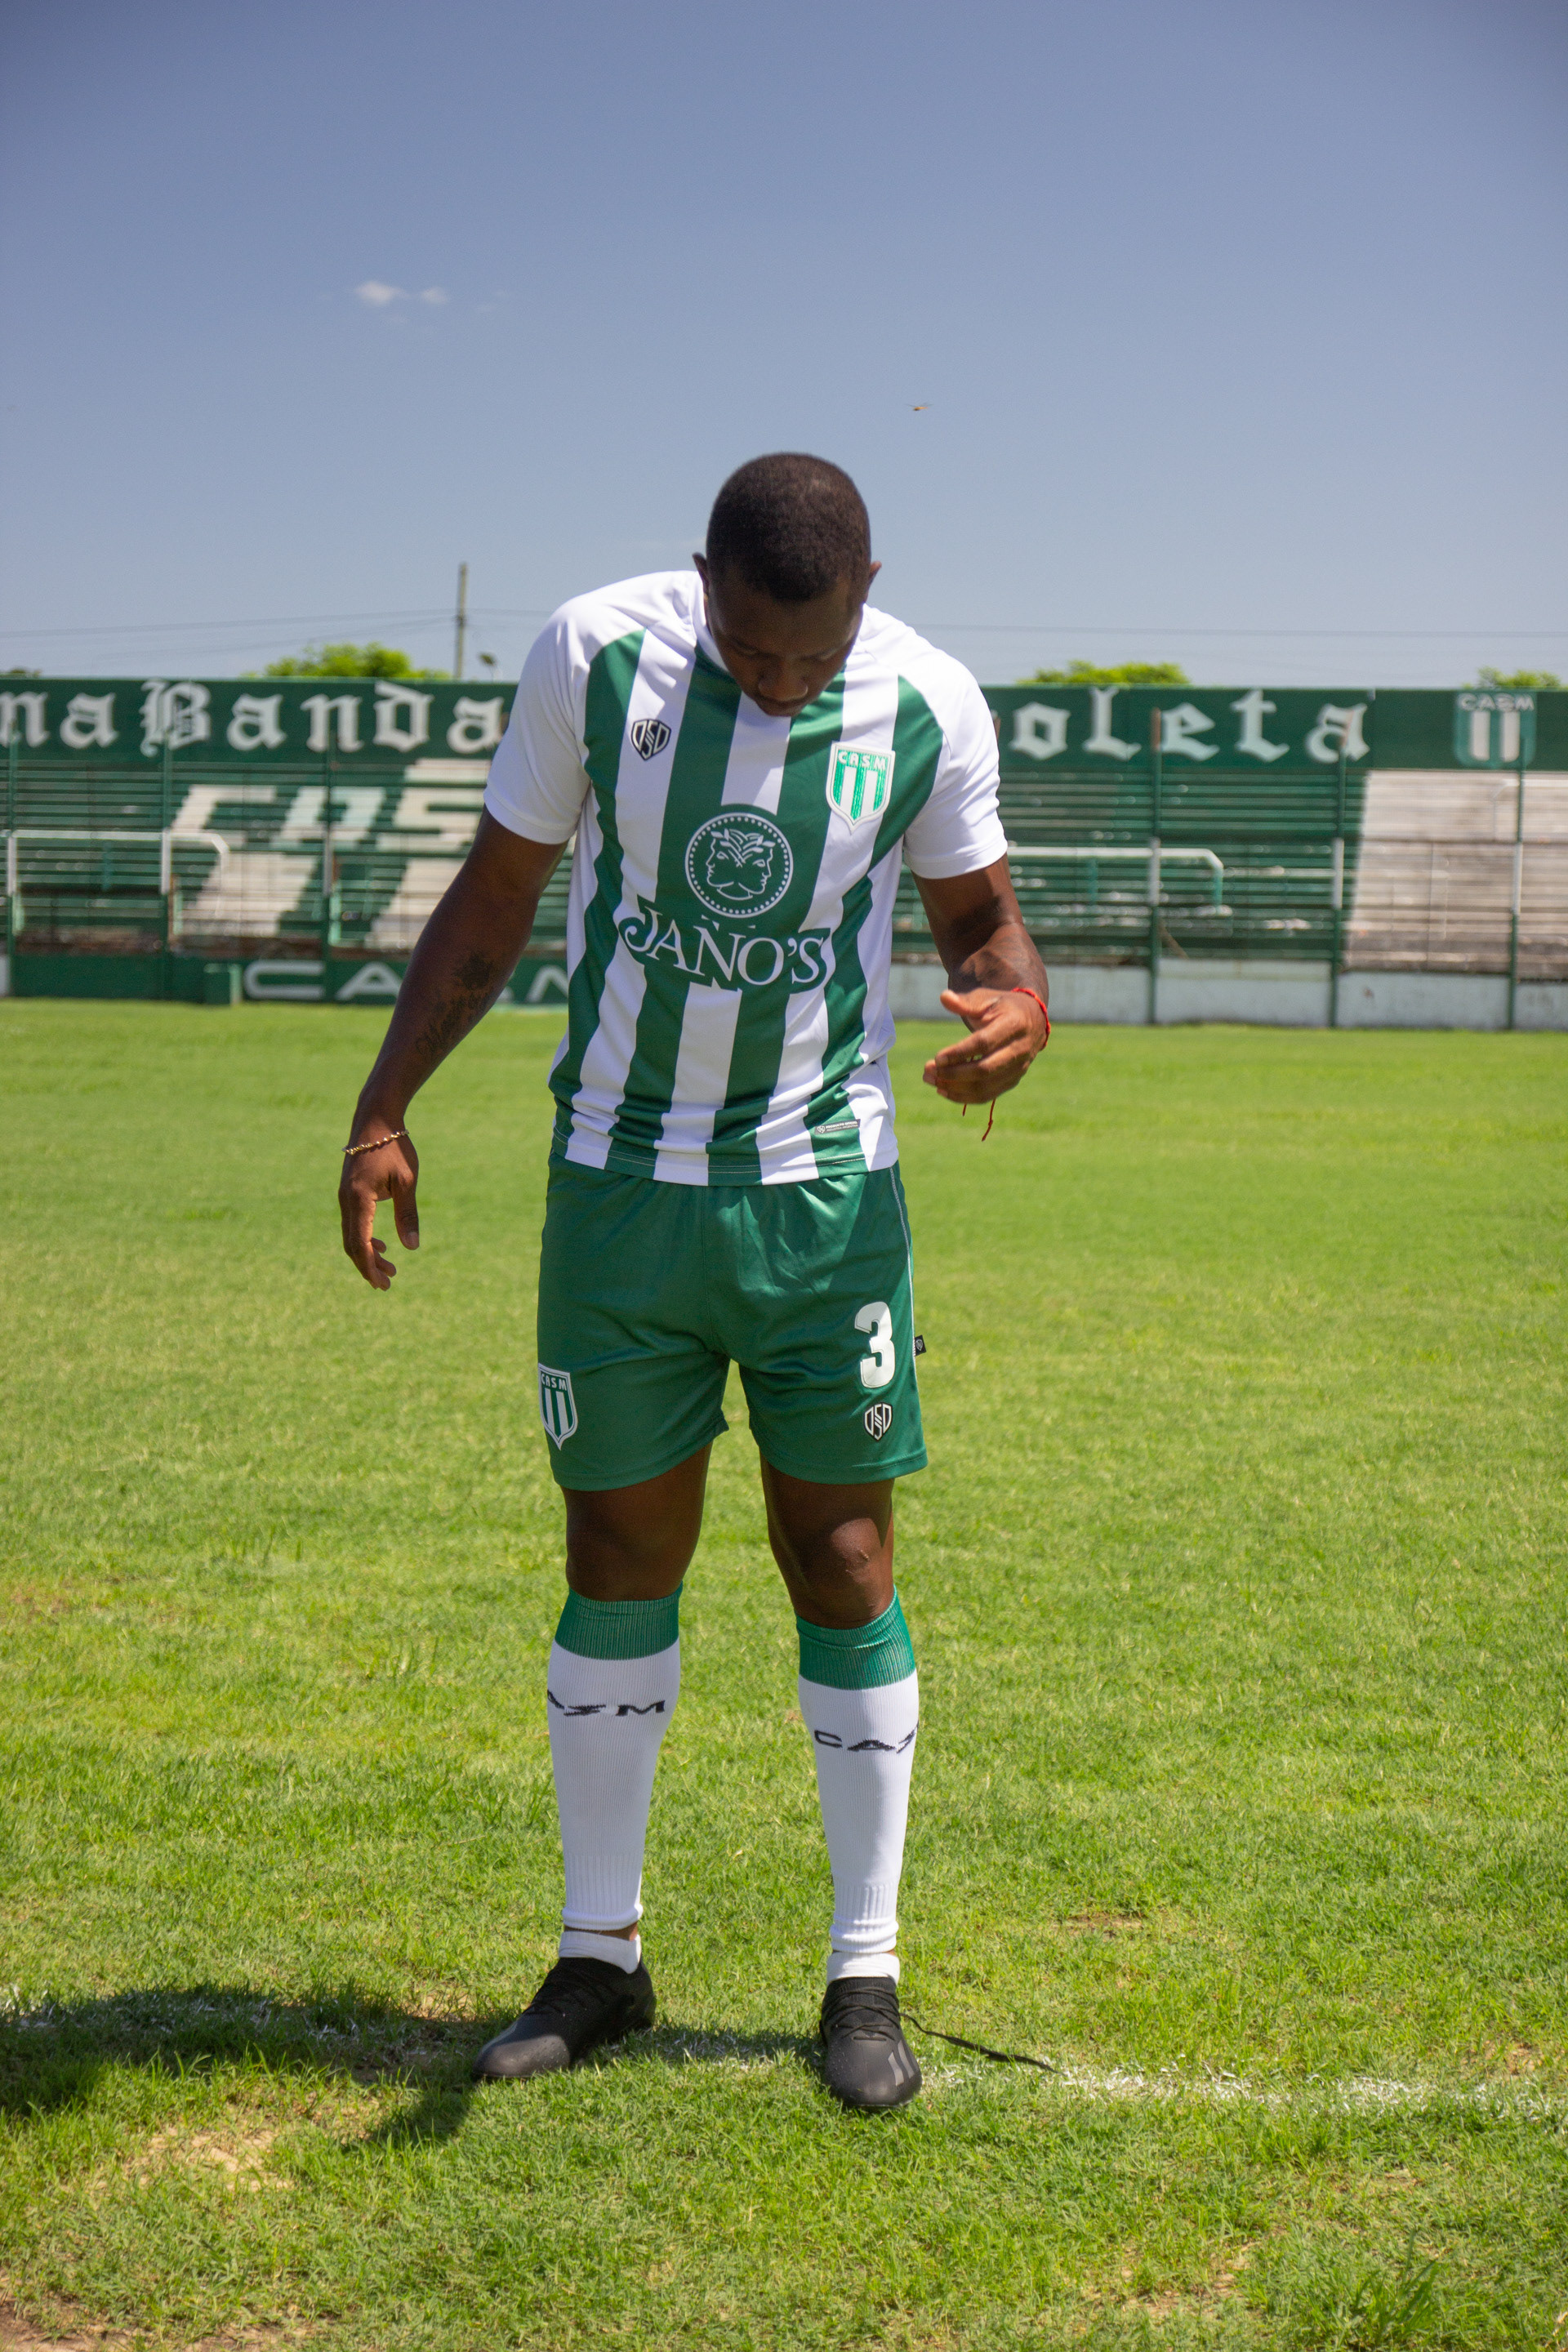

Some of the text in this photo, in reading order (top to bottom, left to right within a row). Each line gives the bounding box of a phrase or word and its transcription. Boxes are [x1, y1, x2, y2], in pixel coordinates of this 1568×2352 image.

[991, 686, 1371, 763] oleta
[1457, 692, 1535, 712] CASM
[837, 750, 887, 772] CASM
[625, 906, 824, 986] JANO'S
[854, 1301, 896, 1388] 3
[541, 1373, 568, 1391] CASM
